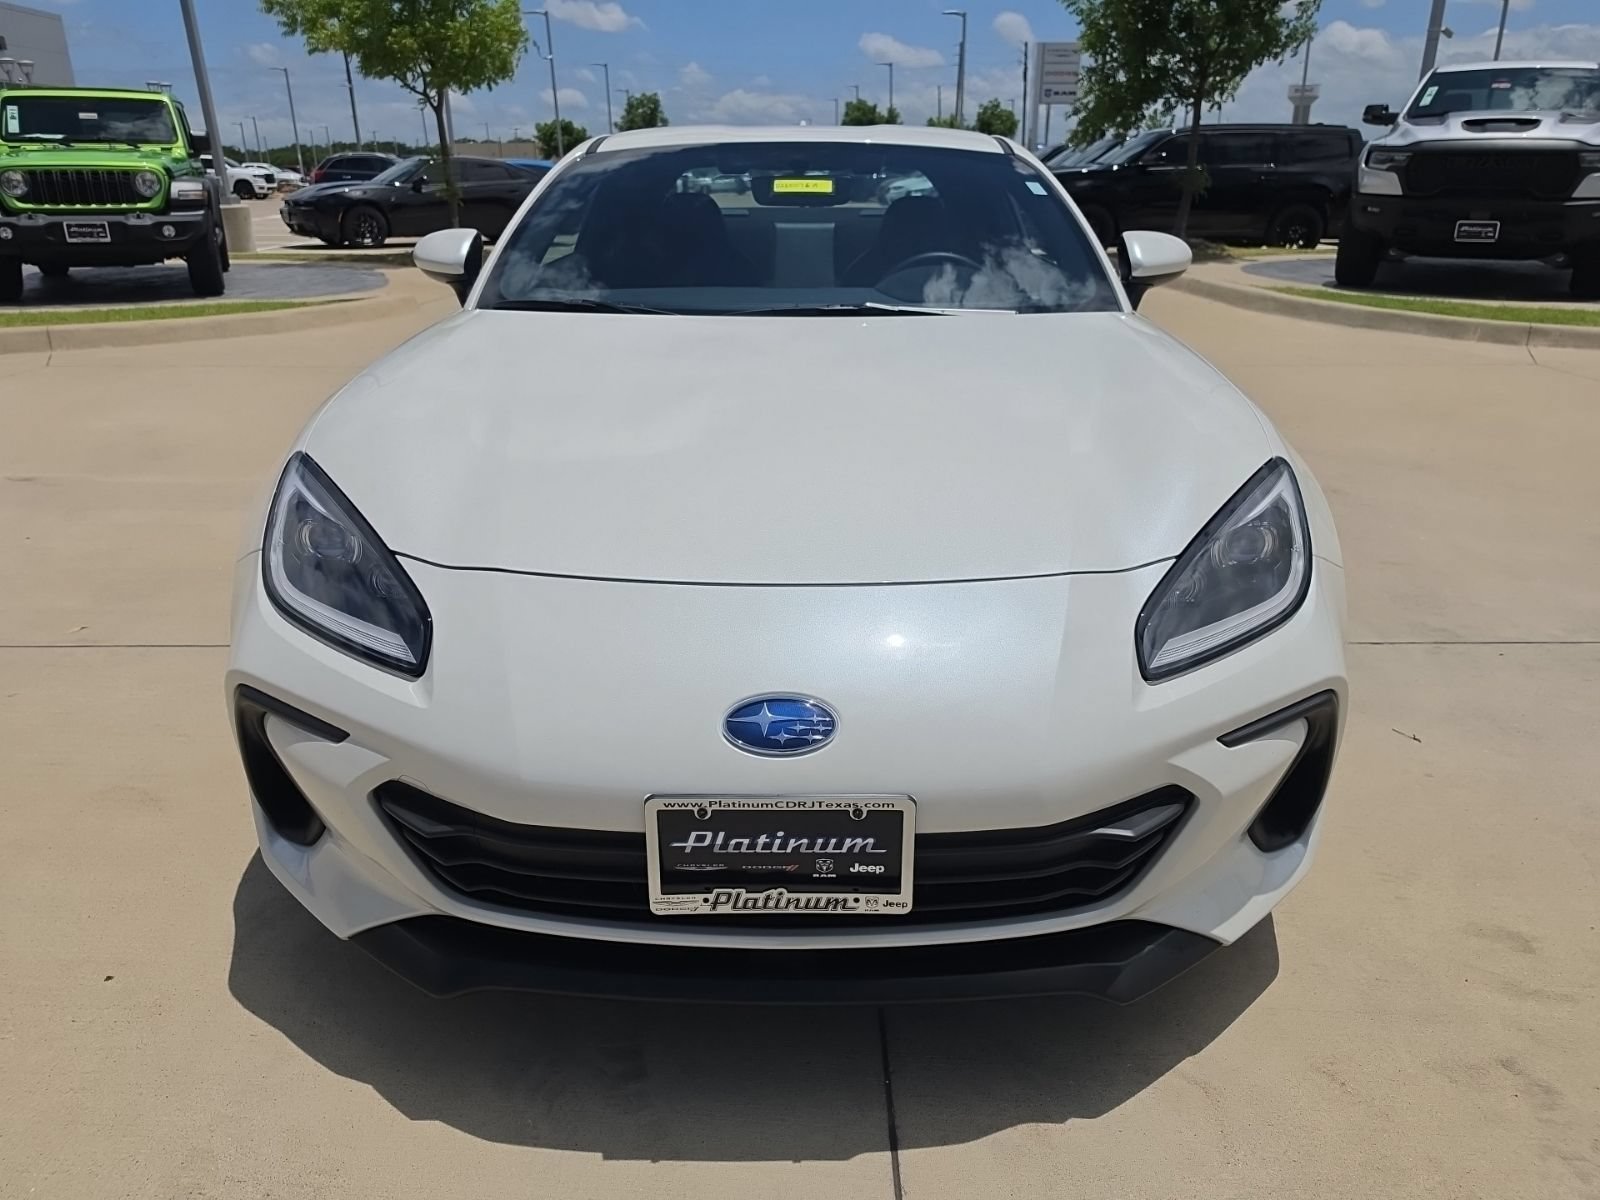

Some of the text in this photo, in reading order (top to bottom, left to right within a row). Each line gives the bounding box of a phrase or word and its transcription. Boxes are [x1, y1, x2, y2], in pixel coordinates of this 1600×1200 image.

[663, 800, 895, 810] www.PlatinumCDRJTexas.com
[669, 831, 888, 854] Platinum
[849, 863, 885, 874] Jeep
[700, 890, 859, 912] Platinum
[882, 899, 908, 909] Jeep
